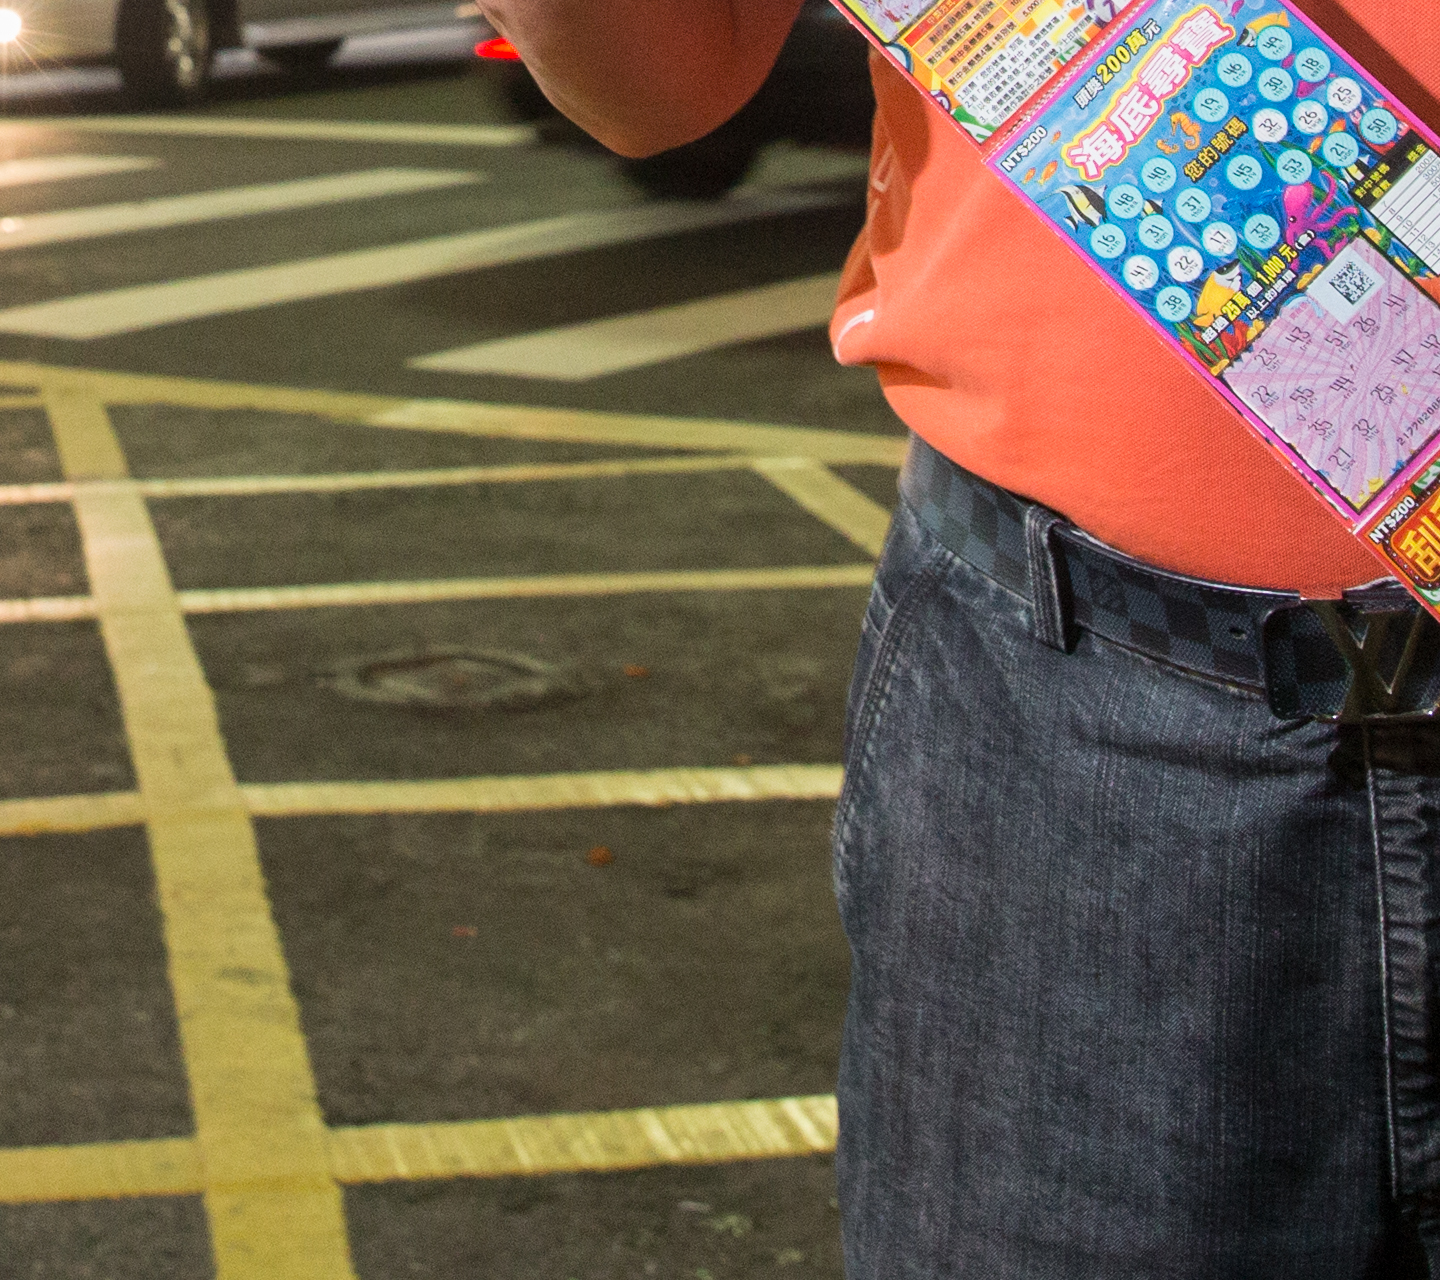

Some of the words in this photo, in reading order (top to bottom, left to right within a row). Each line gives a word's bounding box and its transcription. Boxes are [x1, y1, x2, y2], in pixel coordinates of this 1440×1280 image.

[1264, 34, 1280, 51] 49
[1070, 15, 1162, 109] 頭獎200萬元
[1303, 56, 1318, 71] 18
[1266, 75, 1282, 91] 30
[1065, 2, 1231, 183] 海底尋寶
[1334, 84, 1350, 101] 25
[1202, 96, 1217, 111] 19
[1260, 116, 1277, 132] 32
[1300, 108, 1317, 125] 26
[1369, 117, 1386, 134] 50
[1000, 124, 1049, 173] NT$200
[1180, 114, 1249, 183] 您的號碼
[1330, 141, 1346, 157] 21
[1149, 164, 1166, 182] 40
[1234, 162, 1251, 179] 45
[1115, 192, 1132, 208] 48
[1098, 231, 1114, 247] 16
[1147, 223, 1162, 238] 31
[1252, 222, 1269, 239] 33
[1131, 263, 1147, 279] 41
[1175, 254, 1192, 271] 22
[1164, 294, 1181, 311] 38
[1354, 313, 1374, 333] 26
[1326, 328, 1345, 347] 51
[1392, 348, 1412, 368] 47
[1331, 374, 1352, 395] 44
[1329, 447, 1350, 468] 27
[1368, 495, 1417, 544] NT$200
